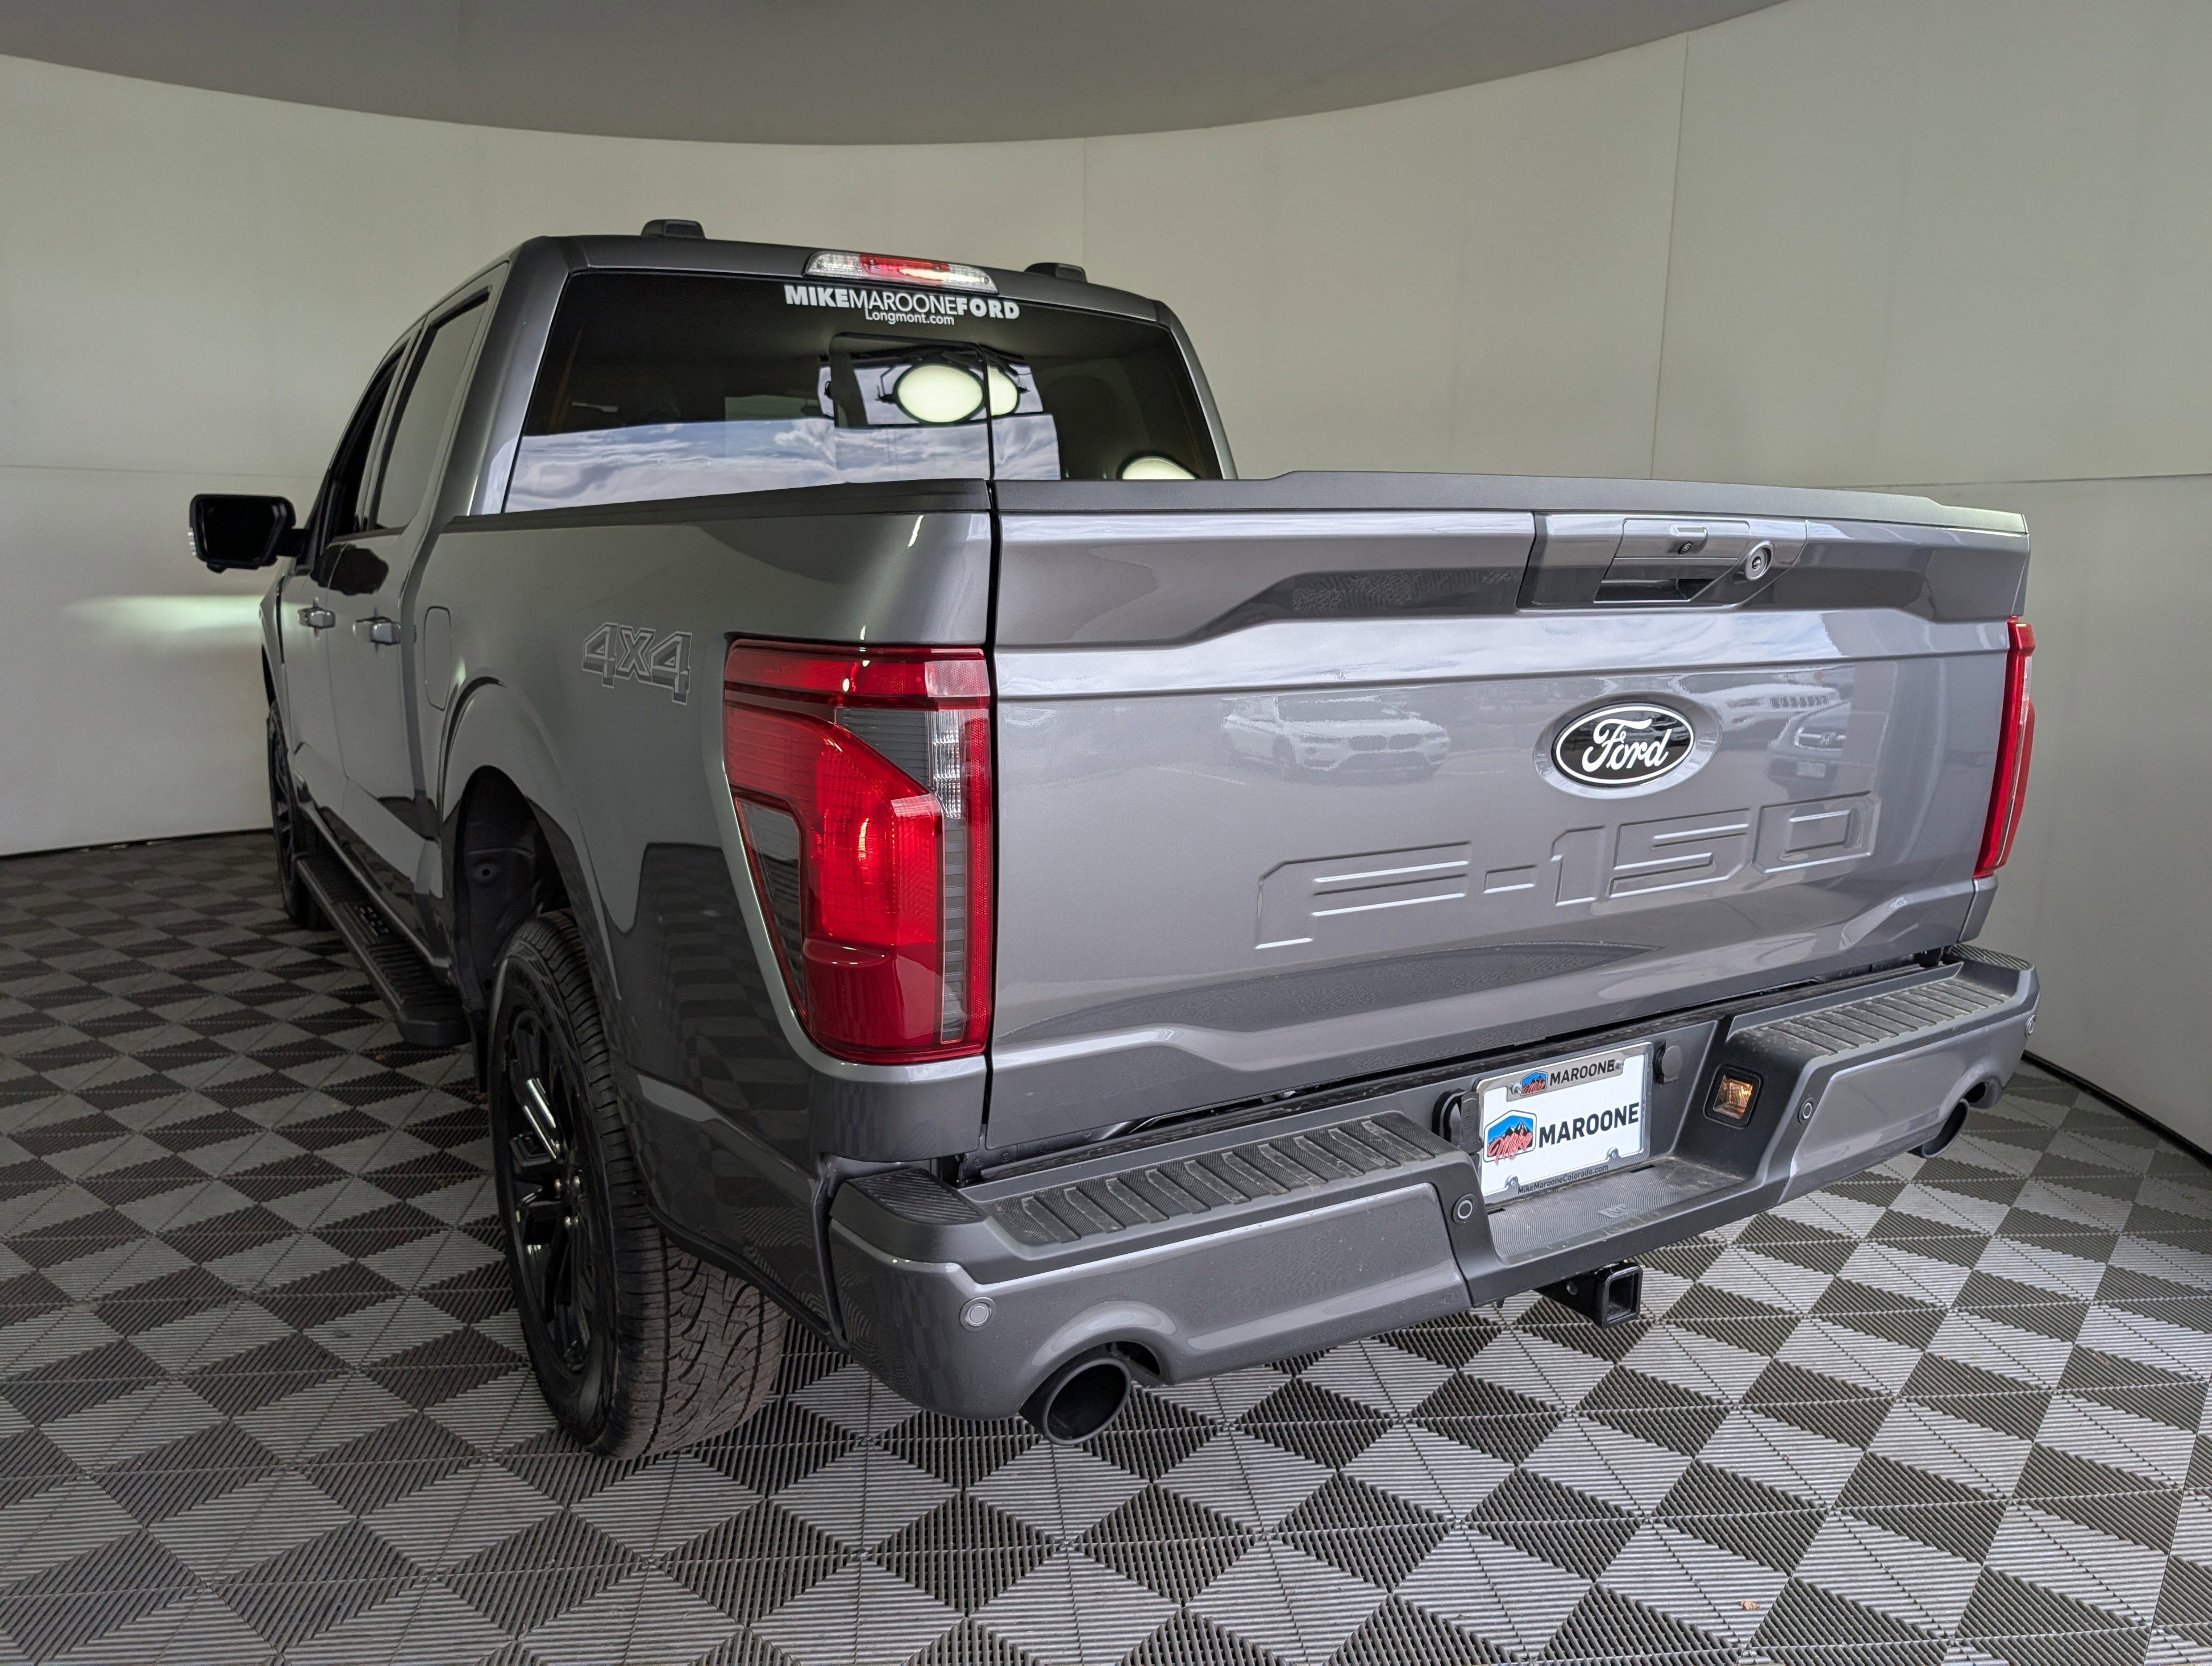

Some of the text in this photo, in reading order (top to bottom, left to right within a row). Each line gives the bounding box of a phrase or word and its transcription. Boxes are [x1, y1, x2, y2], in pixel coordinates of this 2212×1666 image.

[783, 284, 1020, 319] MIKEMAROONEFORD
[865, 308, 955, 325] Longmont.com
[1582, 718, 1672, 772] Ford
[1254, 791, 1881, 949] F-150
[1550, 1059, 1615, 1086] MAROONE
[1487, 1102, 1639, 1165] Mike MAROONE
[1518, 1164, 1609, 1195] MikeMarooneColorado.com
